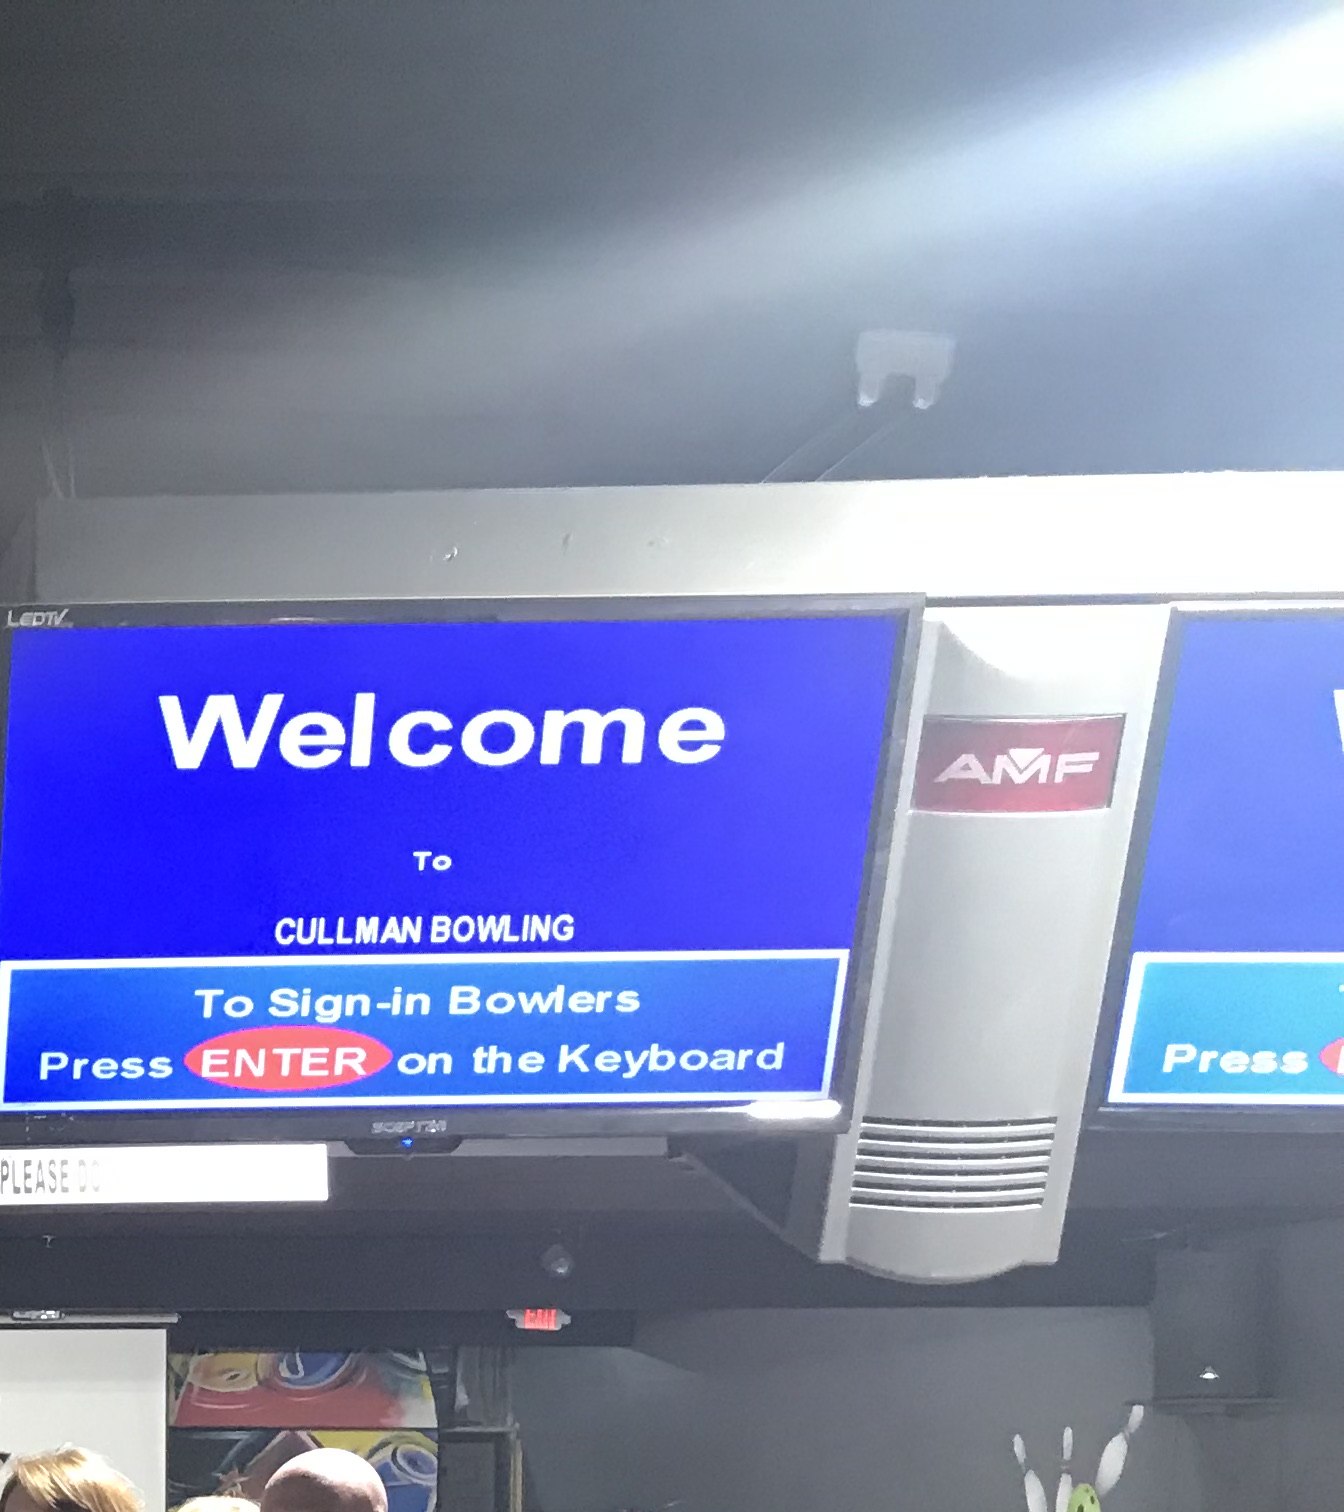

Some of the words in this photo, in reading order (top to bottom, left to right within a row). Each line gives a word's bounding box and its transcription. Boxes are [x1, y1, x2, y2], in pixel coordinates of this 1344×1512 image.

[159, 692, 726, 769] Welcome
[934, 747, 1100, 784] AMF
[413, 851, 452, 871] To
[274, 916, 422, 945] CULLMAN
[431, 914, 575, 943] BOWLING
[195, 989, 253, 1018] To
[269, 986, 430, 1023] Sign-in
[449, 984, 641, 1015] Bowlers
[40, 1052, 173, 1080] Press
[200, 1046, 367, 1078] ENTER
[398, 1052, 453, 1075] on
[472, 1045, 546, 1074] the
[558, 1041, 785, 1079] Keyboard
[1162, 1043, 1309, 1074] Press
[0, 1158, 70, 1195] PLEASE
